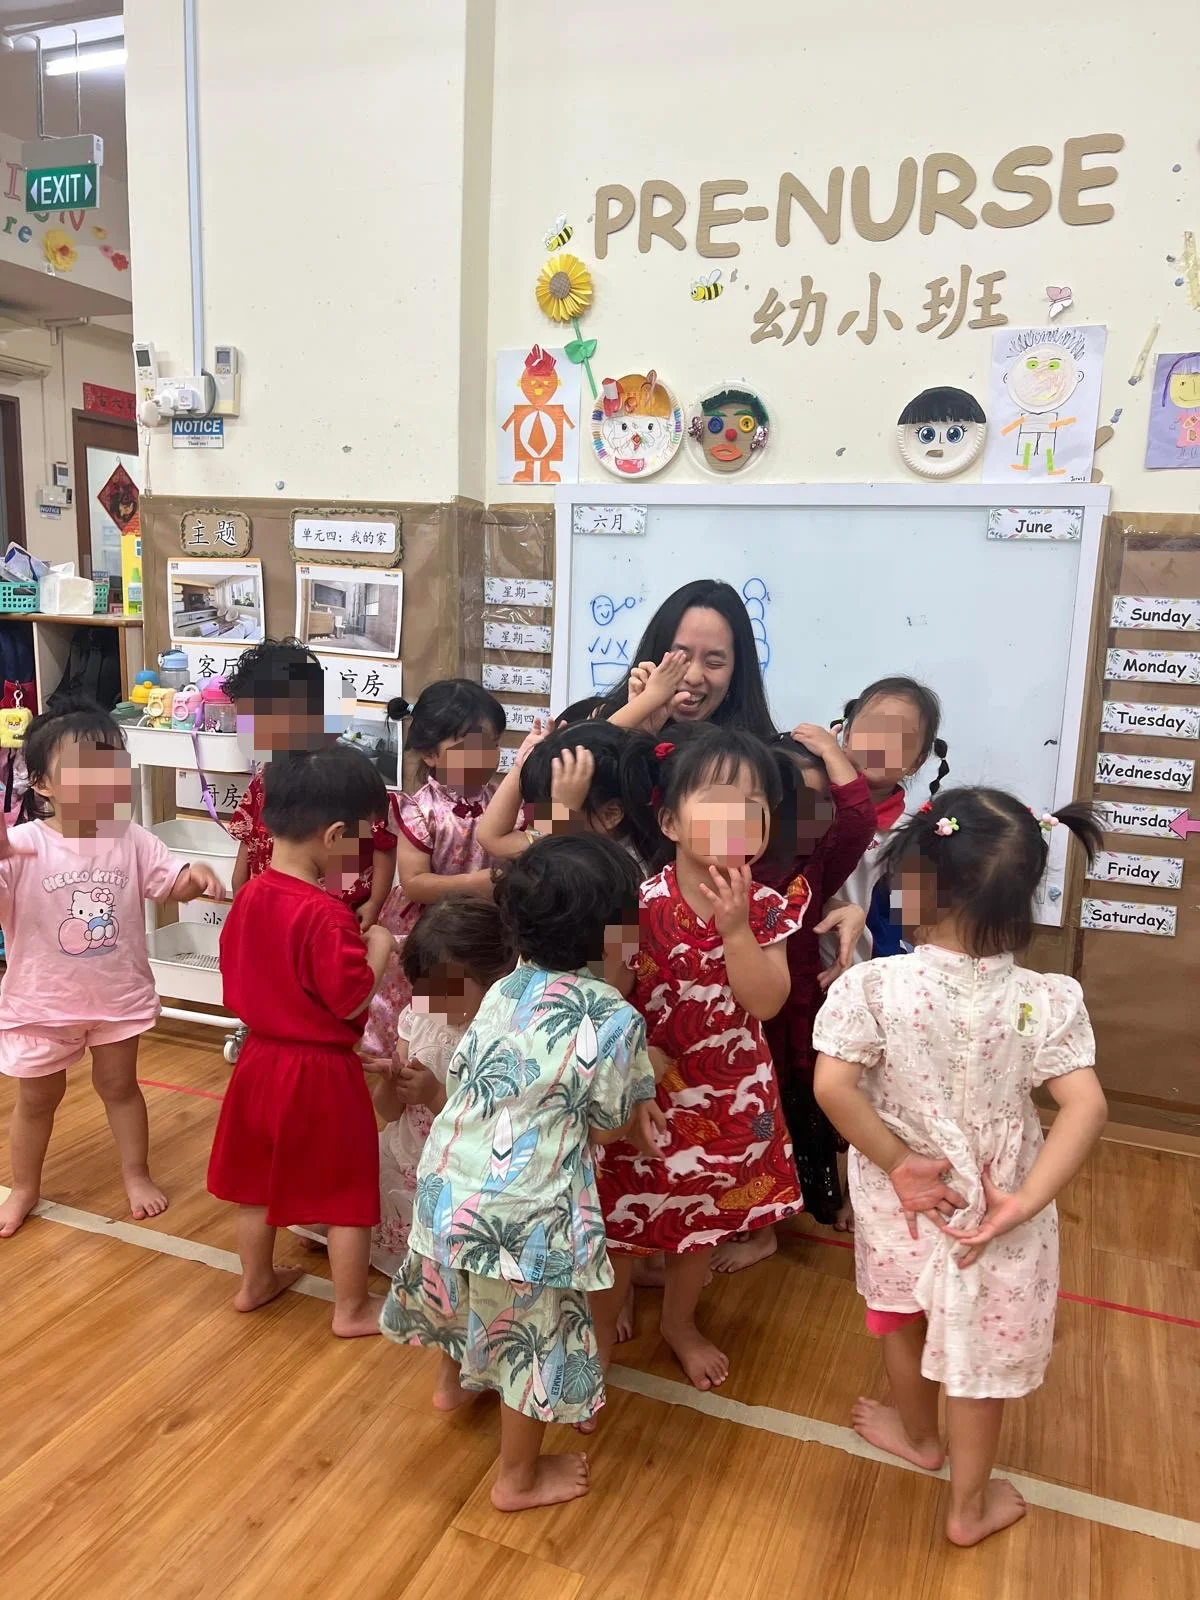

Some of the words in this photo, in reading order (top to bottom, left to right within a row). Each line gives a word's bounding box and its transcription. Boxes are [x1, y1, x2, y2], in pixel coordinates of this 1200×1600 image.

[41, 174, 81, 205] EXIT
[595, 132, 1125, 260] PRE-NURSE
[750, 264, 1009, 346] 幼小班
[174, 420, 221, 433] NOTICE
[593, 514, 622, 531] 六月
[1015, 519, 1053, 534] June
[188, 519, 237, 548] 主题
[502, 586, 539, 598] 星期一
[1130, 608, 1192, 627] Sunday
[501, 631, 535, 644] 星期二
[1122, 658, 1187, 678] Monday
[500, 674, 535, 686] 星期三
[1117, 711, 1186, 732] Tuesday
[1098, 762, 1192, 786] Wednesday
[42, 870, 91, 893] HELLO
[91, 867, 129, 888] KITTY
[1107, 862, 1160, 882] Friday
[1091, 909, 1166, 930] Saturday
[551, 1364, 564, 1396] SUMMER
